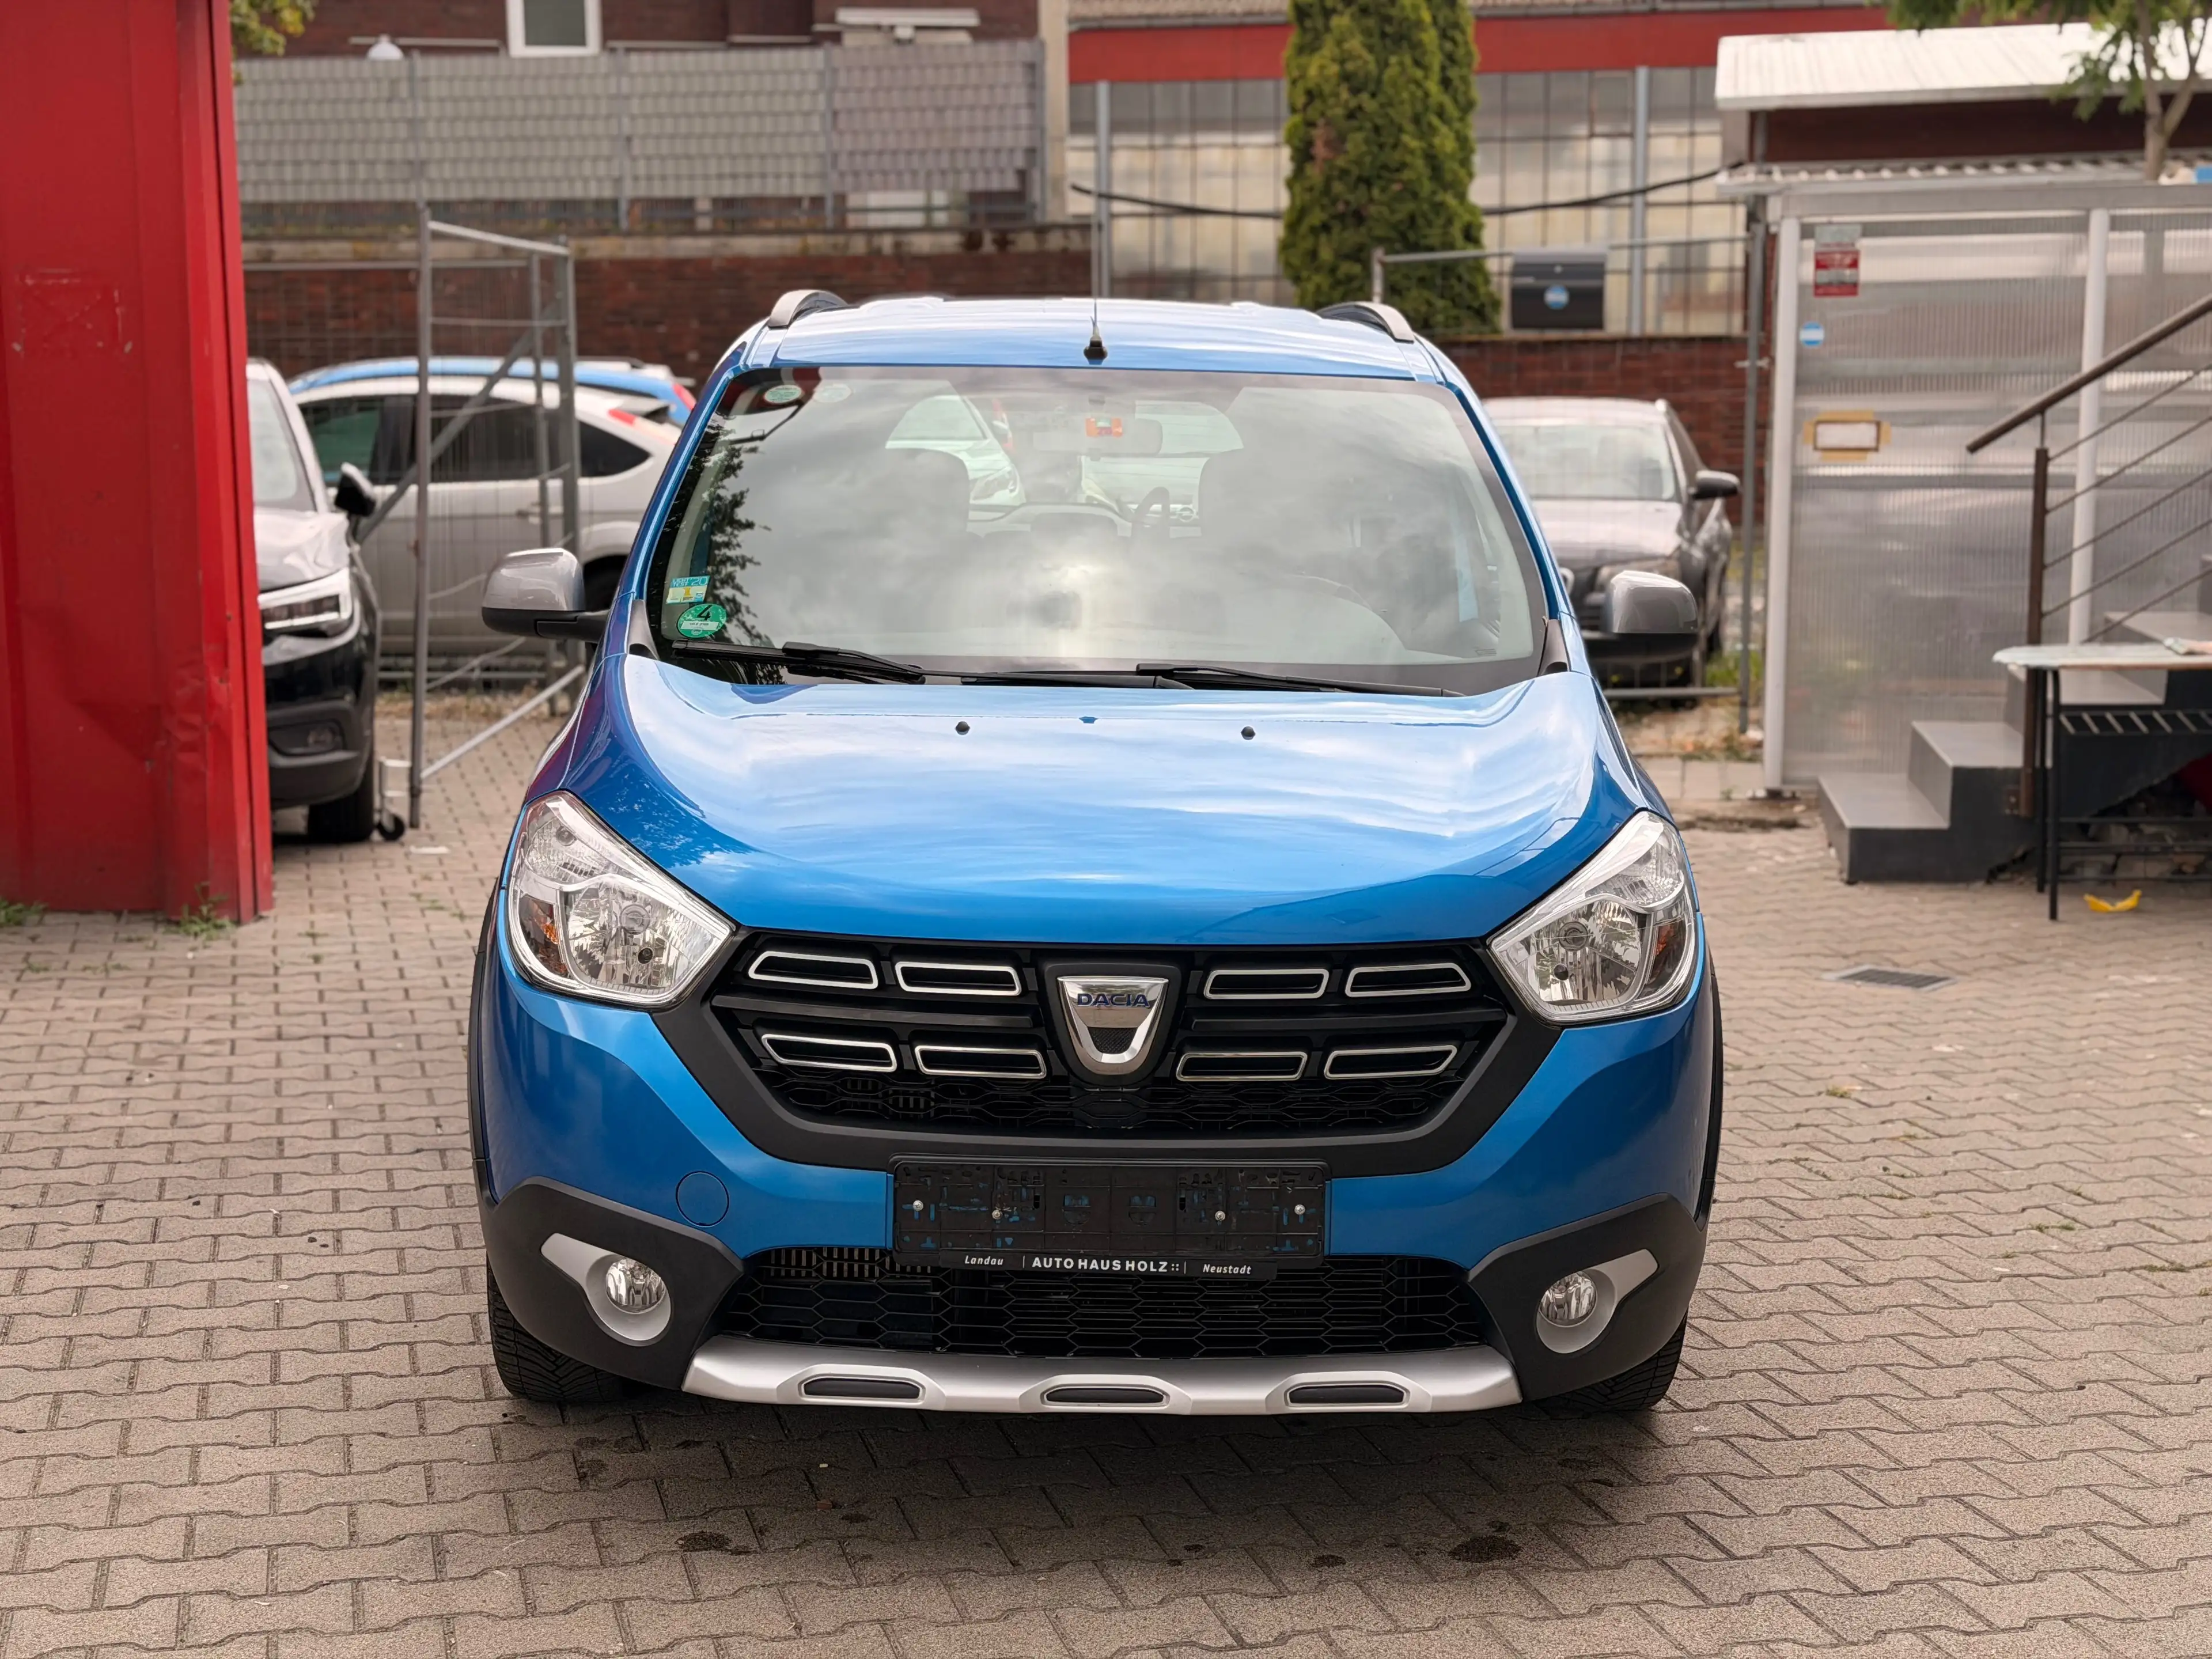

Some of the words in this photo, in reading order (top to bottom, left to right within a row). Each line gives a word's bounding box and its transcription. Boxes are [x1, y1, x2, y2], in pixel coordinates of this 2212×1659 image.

[696, 605, 712, 620] 4
[1077, 993, 1150, 1007] DACIA
[964, 1255, 1003, 1266] Landau
[1032, 1257, 1074, 1269] AUTO
[1078, 1259, 1122, 1271] HAUS
[1125, 1260, 1168, 1272] HOLZ
[1202, 1264, 1252, 1274] Neustadt
